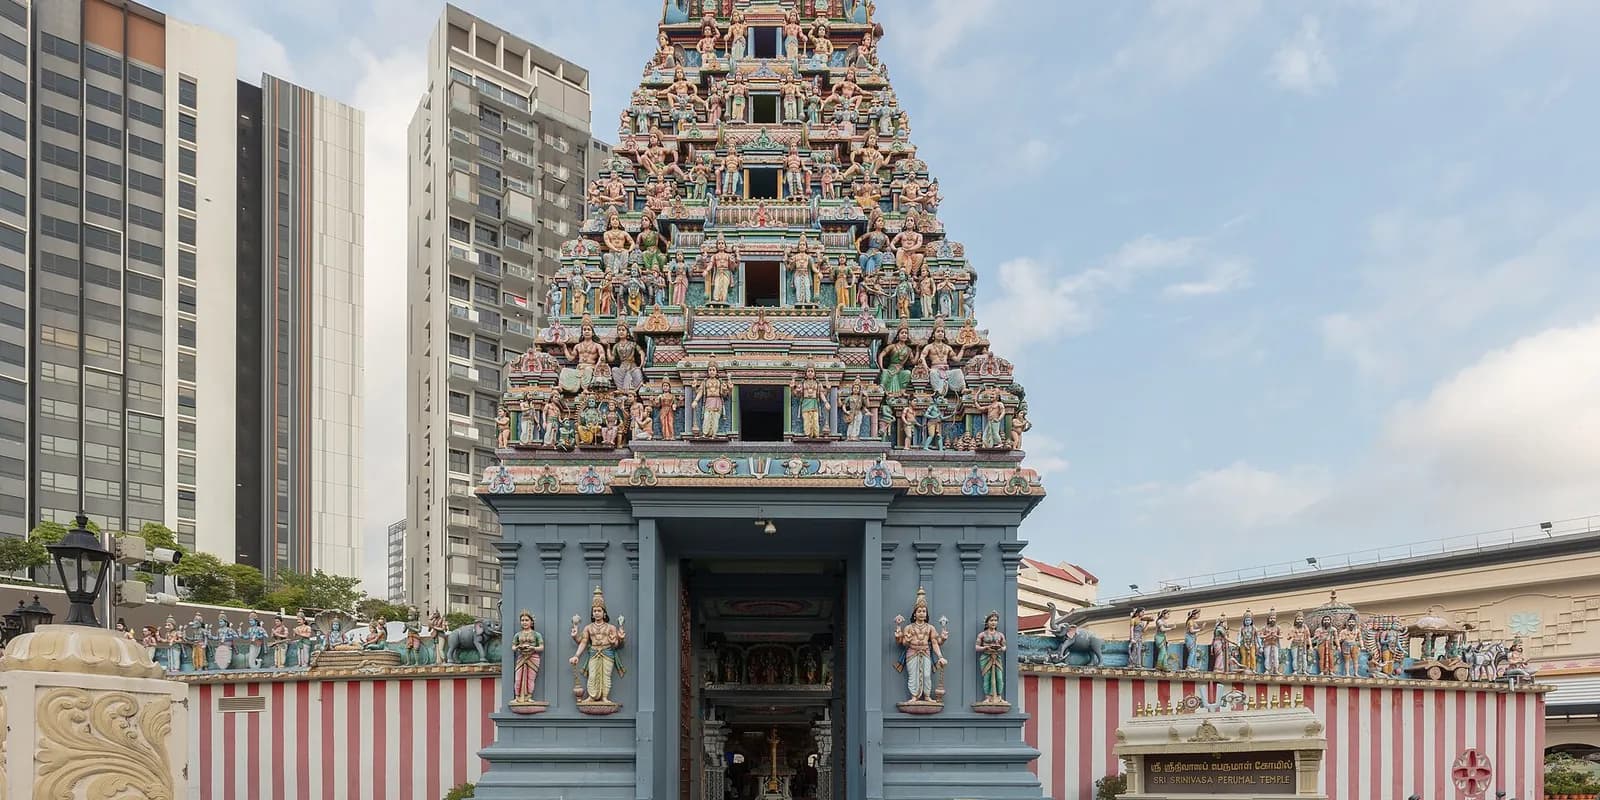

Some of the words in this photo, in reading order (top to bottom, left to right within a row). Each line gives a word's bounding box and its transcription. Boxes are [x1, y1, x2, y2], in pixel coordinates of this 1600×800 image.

[1153, 776, 1167, 784] SRI
[1170, 776, 1214, 784] SRINIVASA
[1217, 775, 1257, 784] PERUMAL
[1259, 775, 1290, 784] TEMPLE
